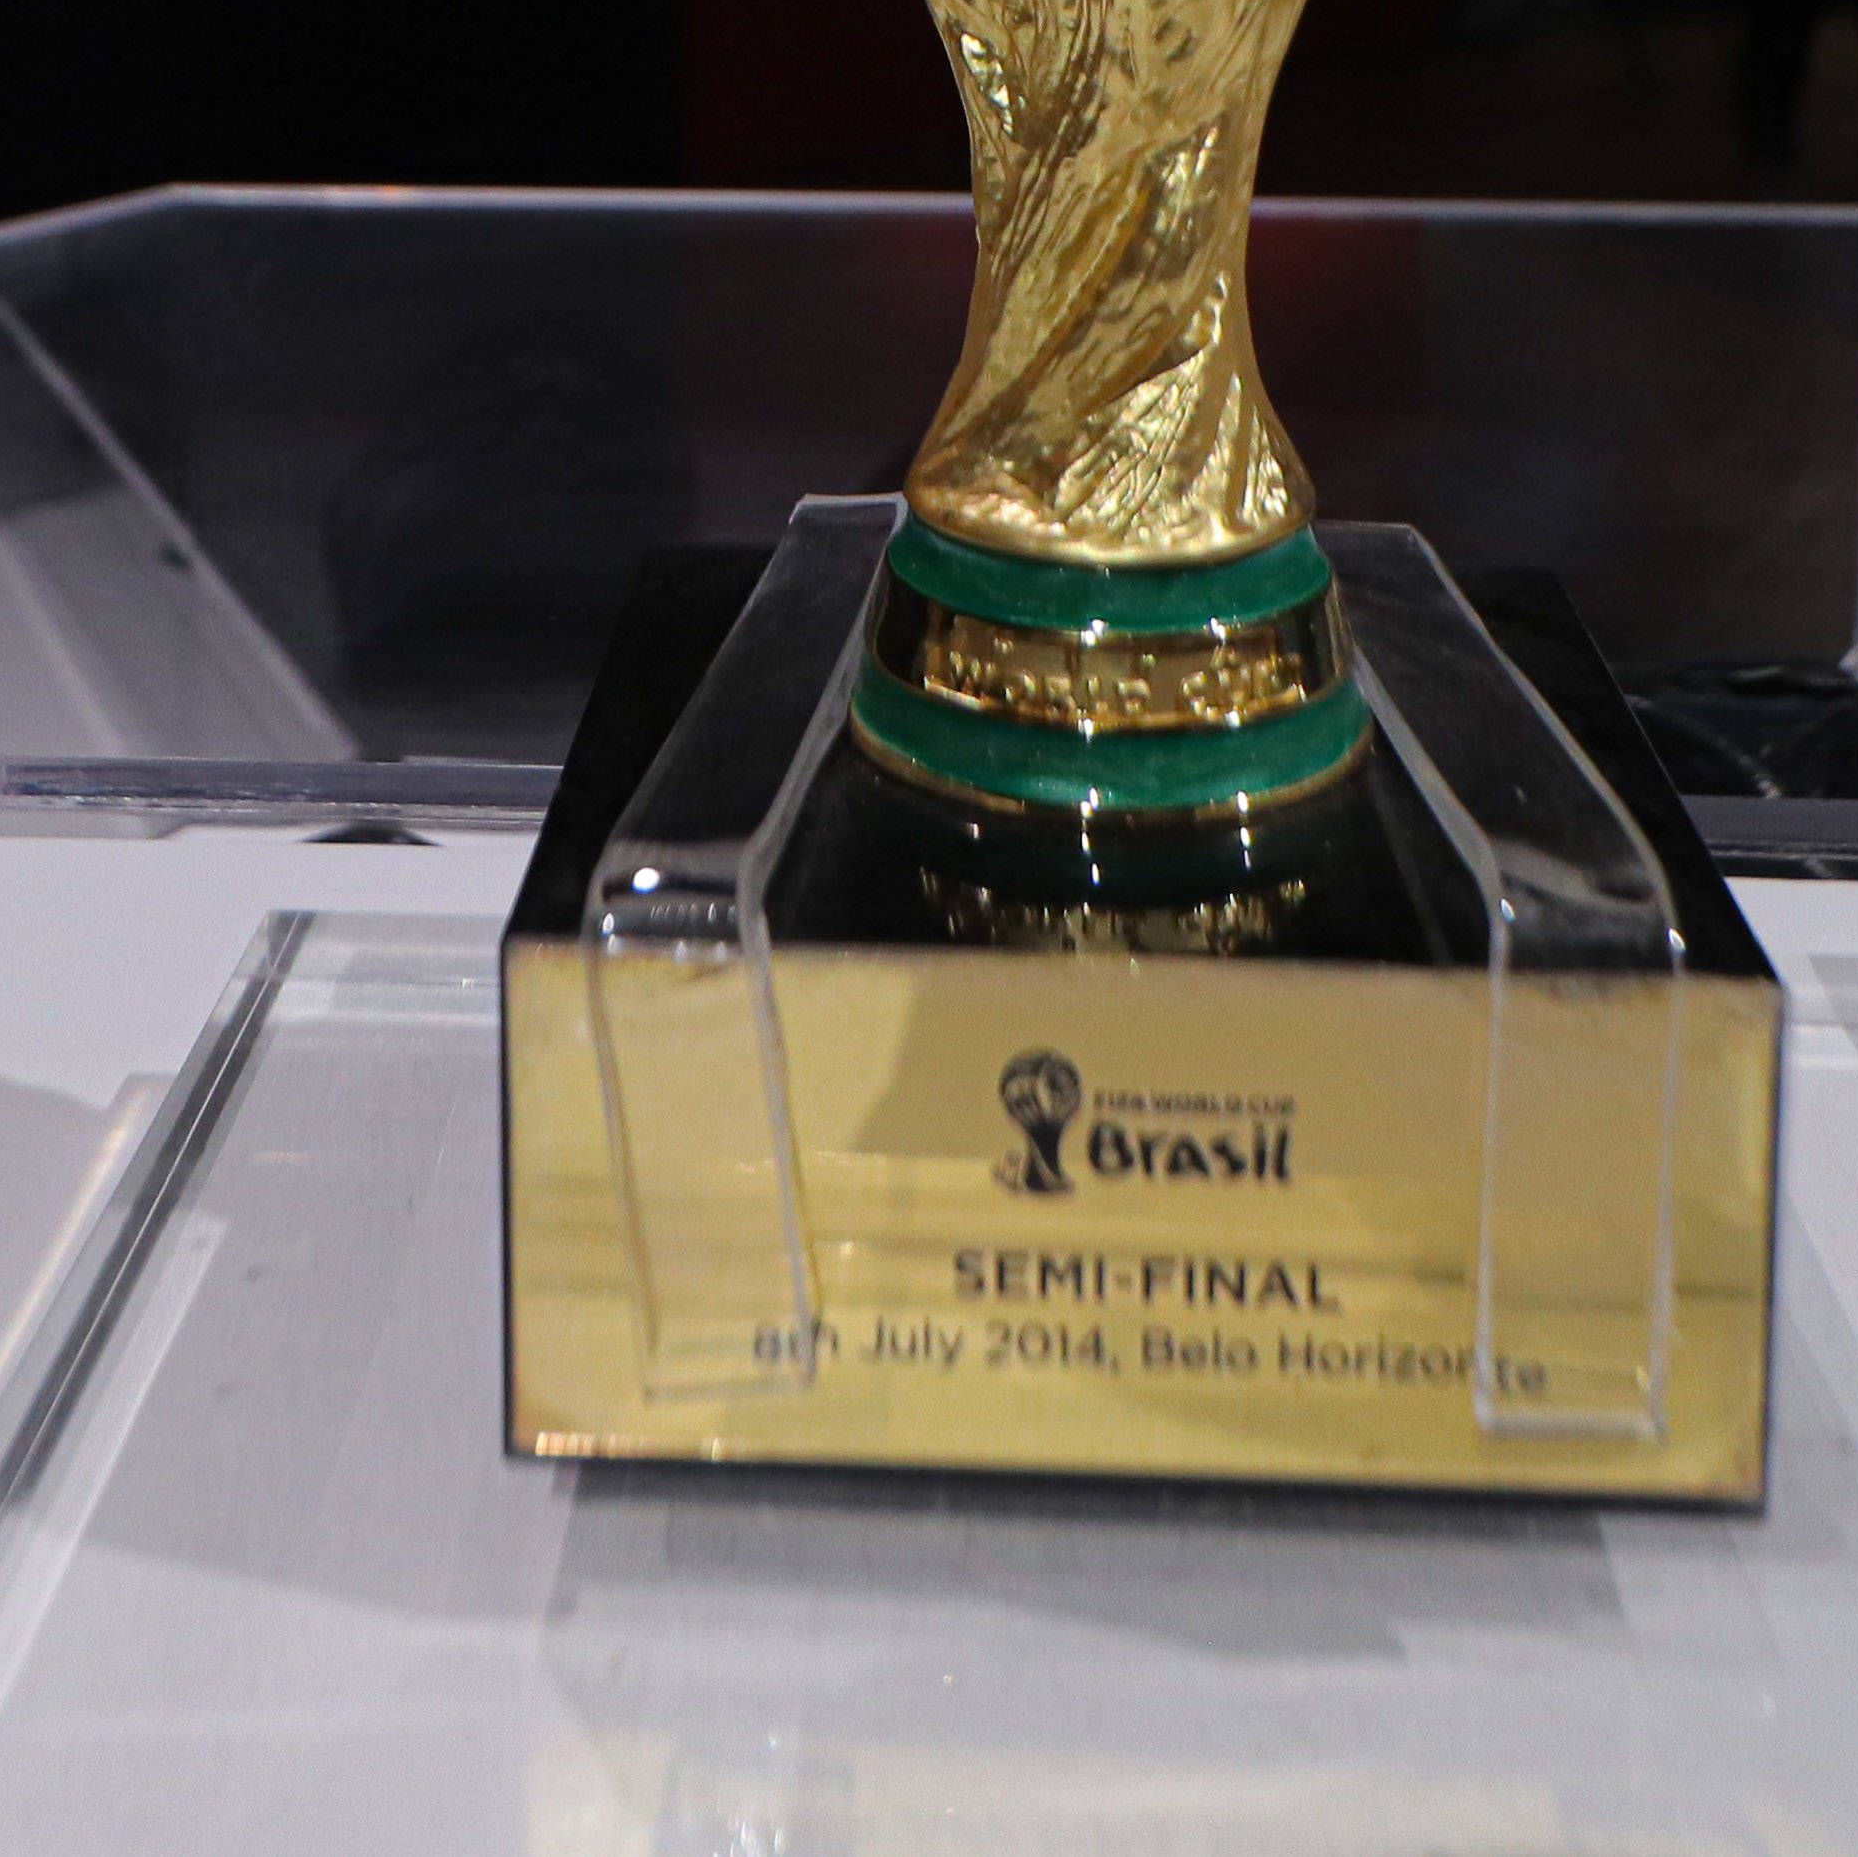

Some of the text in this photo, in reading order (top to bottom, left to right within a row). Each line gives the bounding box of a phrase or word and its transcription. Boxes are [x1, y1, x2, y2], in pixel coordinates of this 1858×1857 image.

[1087, 1116, 1292, 1180] Brasil
[953, 1247, 1341, 1314] SEMI-FINAL
[861, 1316, 964, 1368] July
[985, 1319, 1121, 1376] 2014,
[1142, 1325, 1260, 1374] Belo
